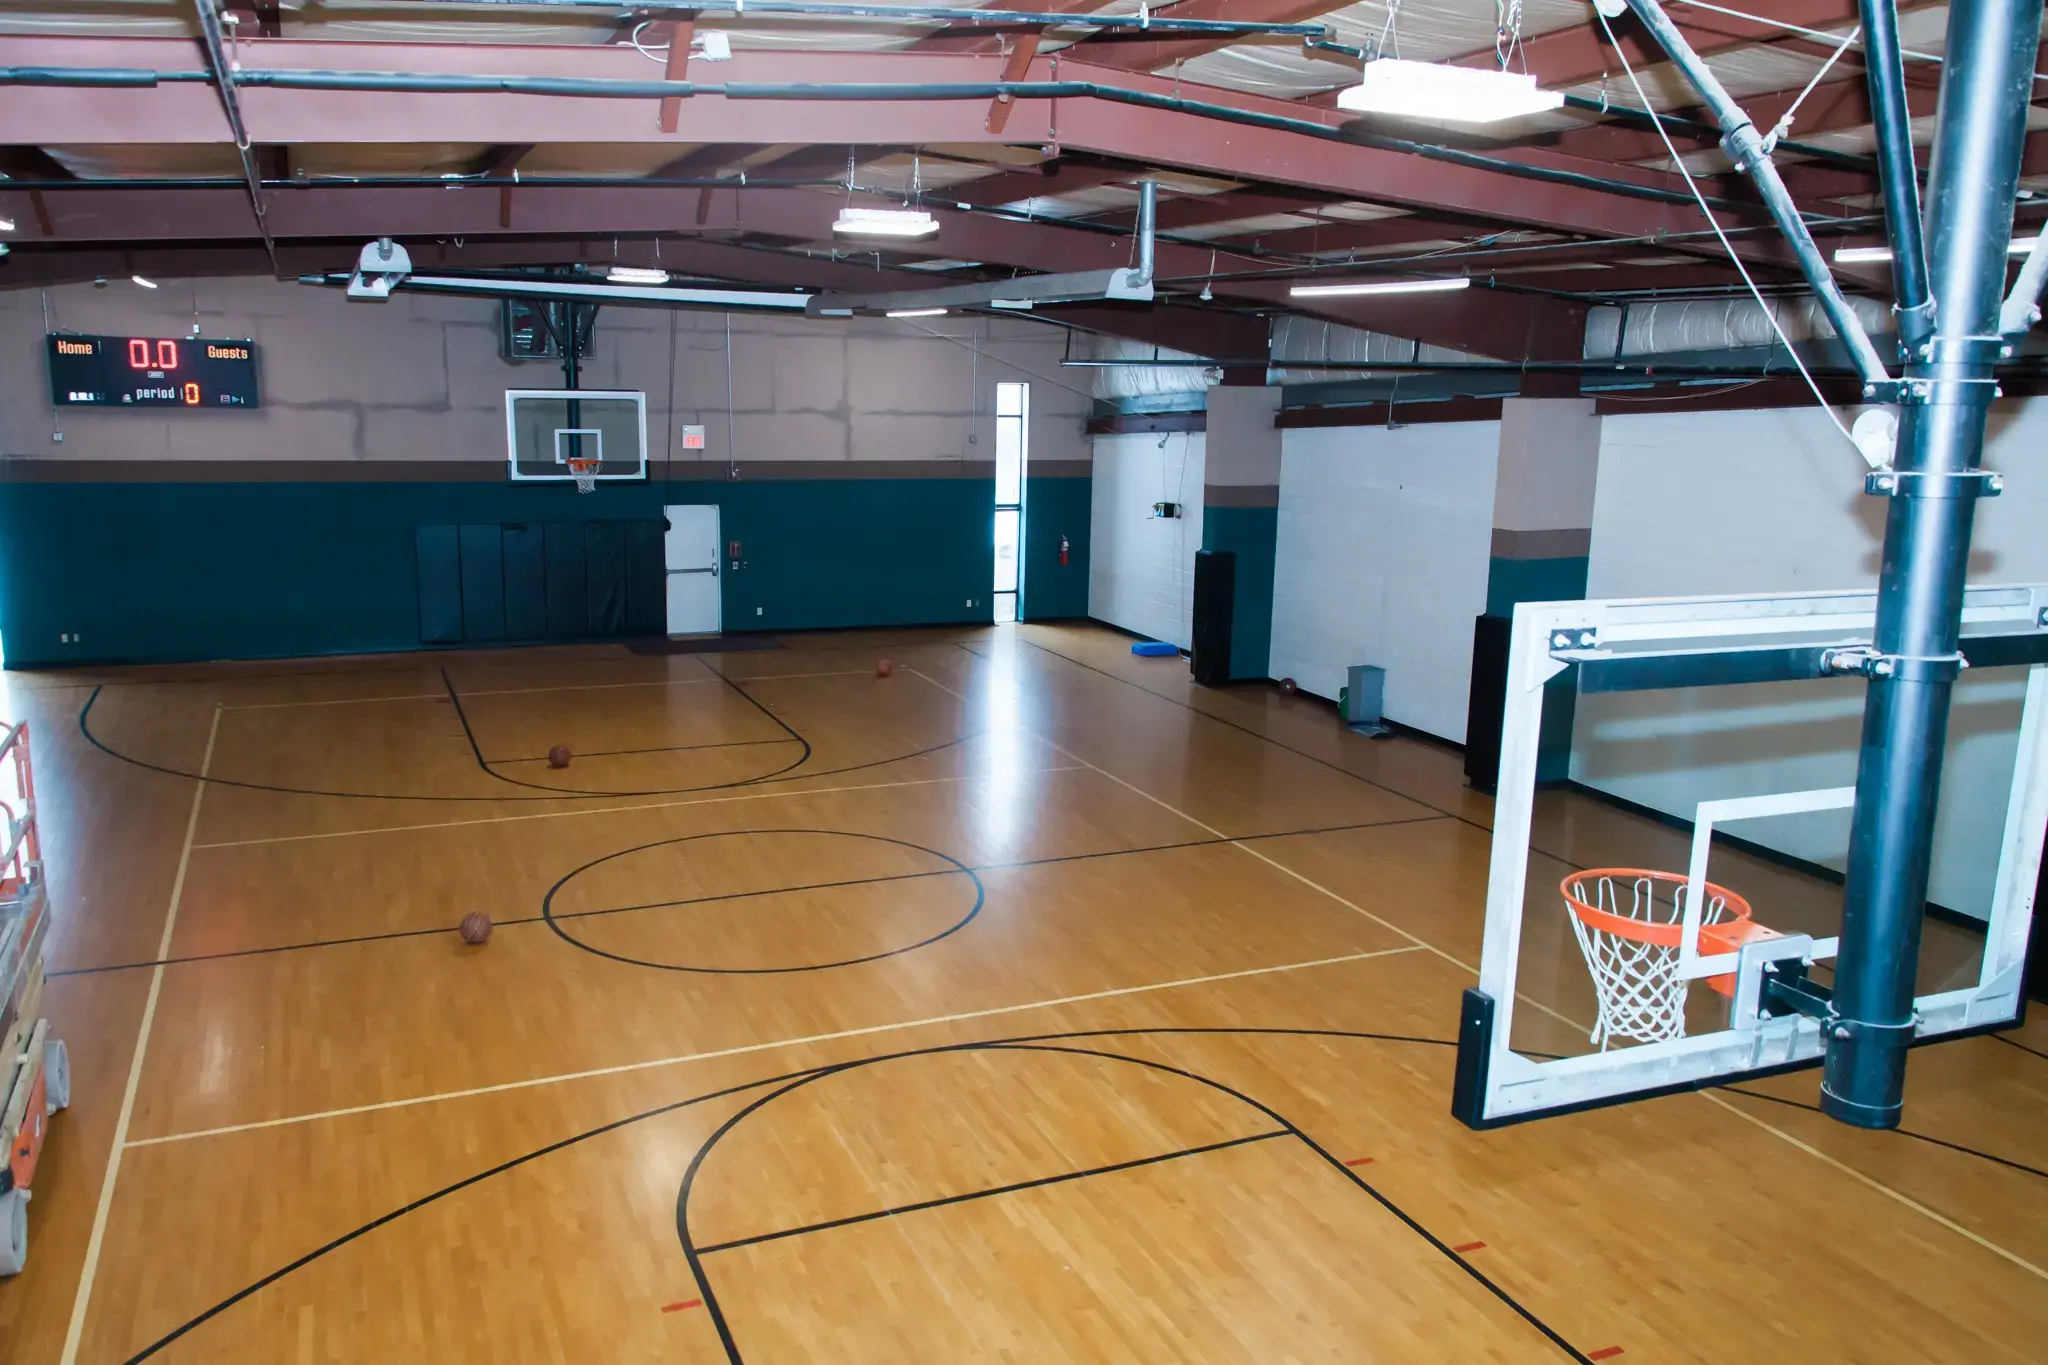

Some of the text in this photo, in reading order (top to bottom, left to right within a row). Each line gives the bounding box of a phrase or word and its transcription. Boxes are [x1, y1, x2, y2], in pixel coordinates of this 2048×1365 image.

[57, 340, 93, 355] Home
[129, 340, 177, 368] 0.0
[207, 345, 249, 359] Guests
[136, 387, 175, 400] period
[184, 383, 200, 404] 0
